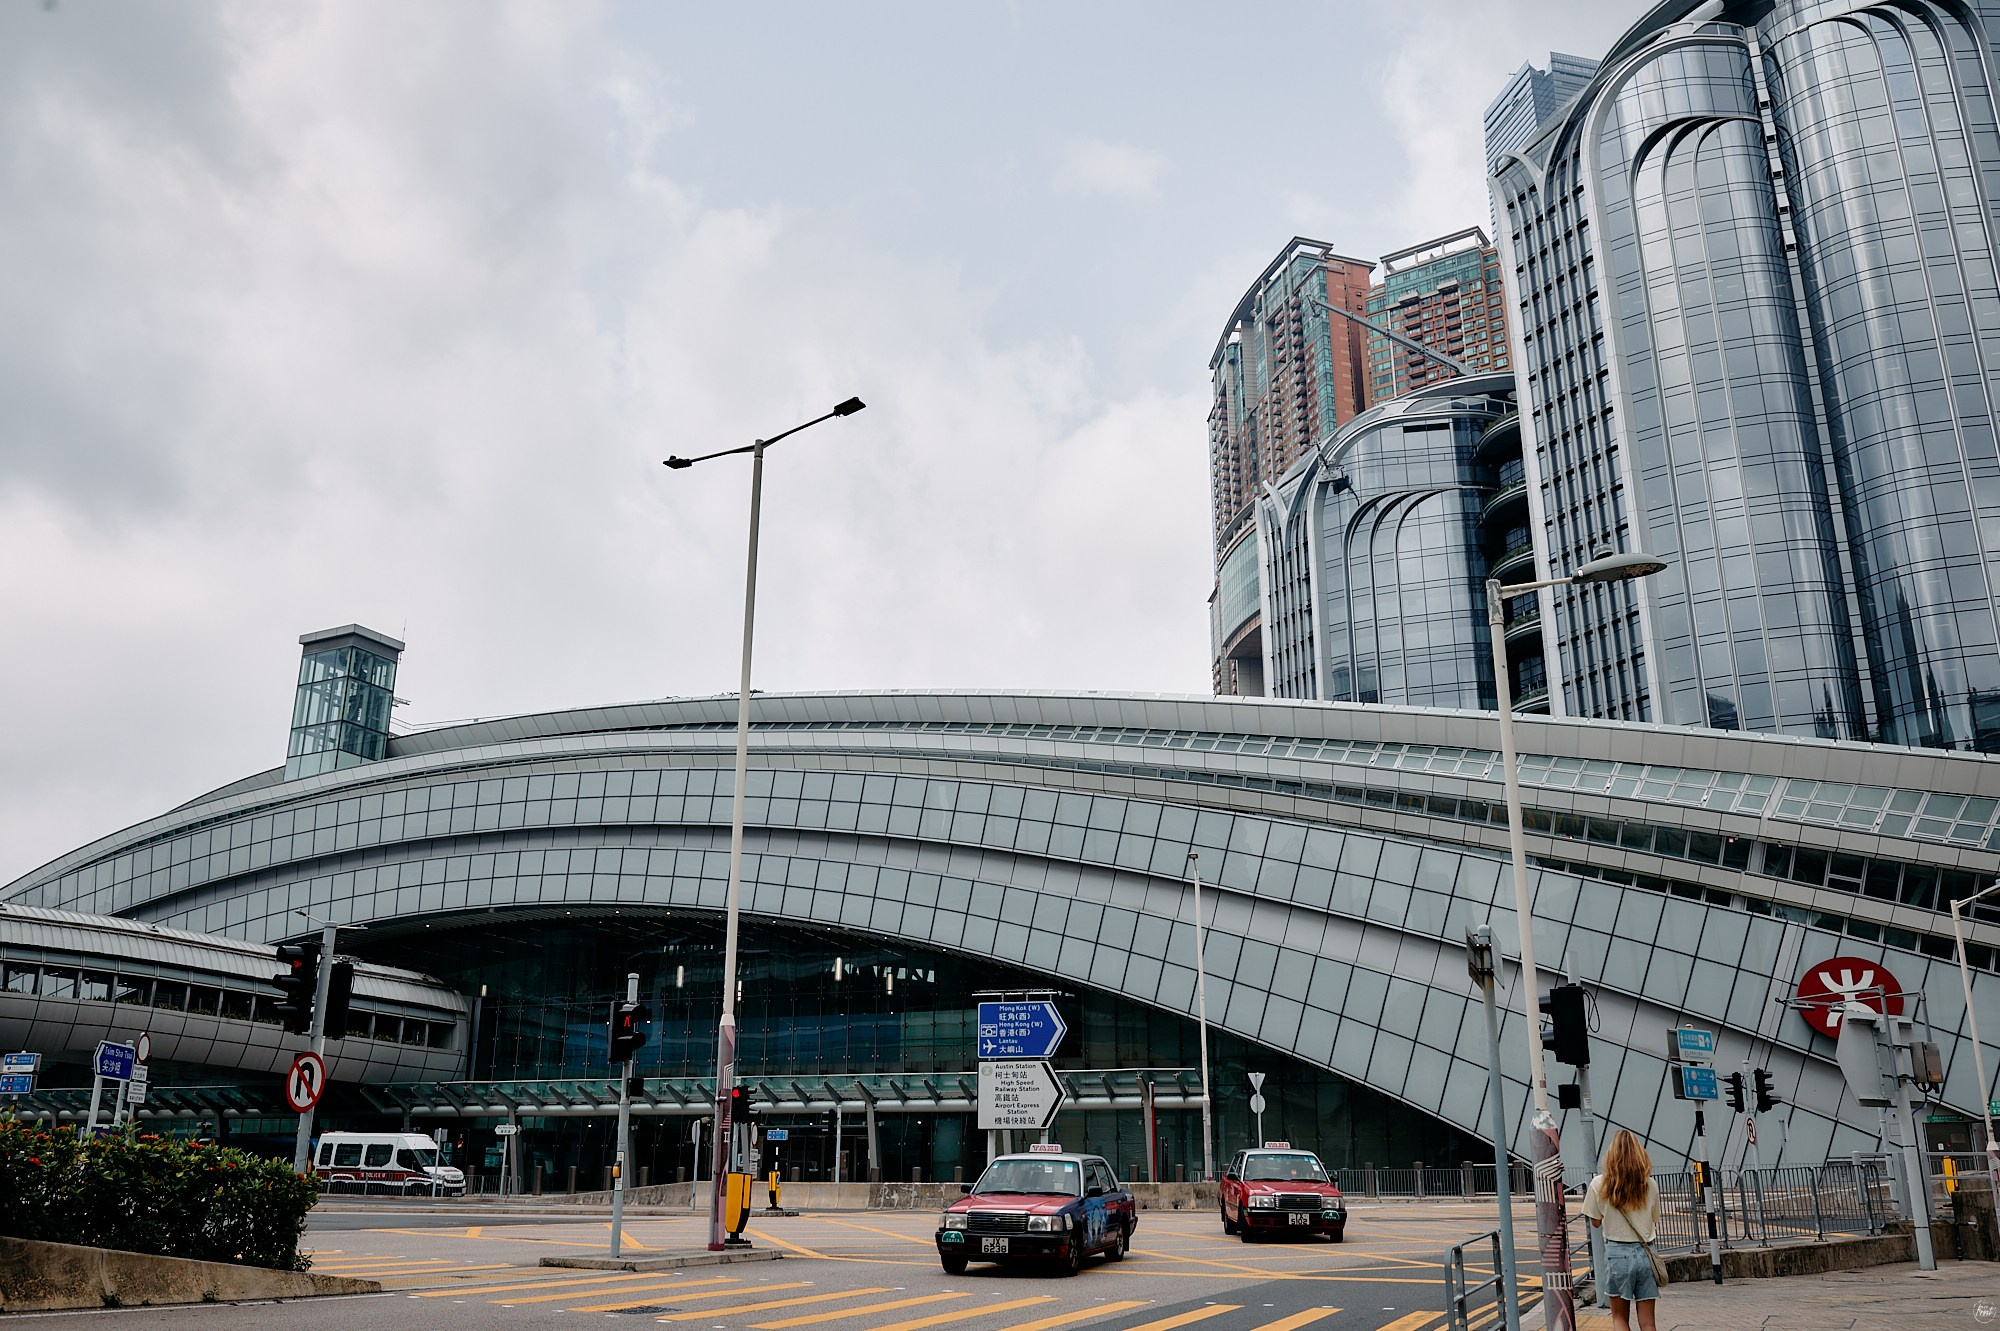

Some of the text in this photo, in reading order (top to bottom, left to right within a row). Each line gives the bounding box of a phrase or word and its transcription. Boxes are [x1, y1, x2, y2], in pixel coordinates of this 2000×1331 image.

[999, 1013, 1031, 1021] 旺角(西)
[999, 1028, 1031, 1037] 香港(西)
[104, 1046, 133, 1060] Tsim Sha Tsui
[999, 1045, 1023, 1054] 大嶼山
[102, 1059, 121, 1074] 尖沙咀
[995, 1071, 1028, 1079] 柯士甸站
[995, 1094, 1019, 1102] 高鐵站
[990, 1238, 1001, 1246] JX
[984, 1245, 1007, 1253] 6238
